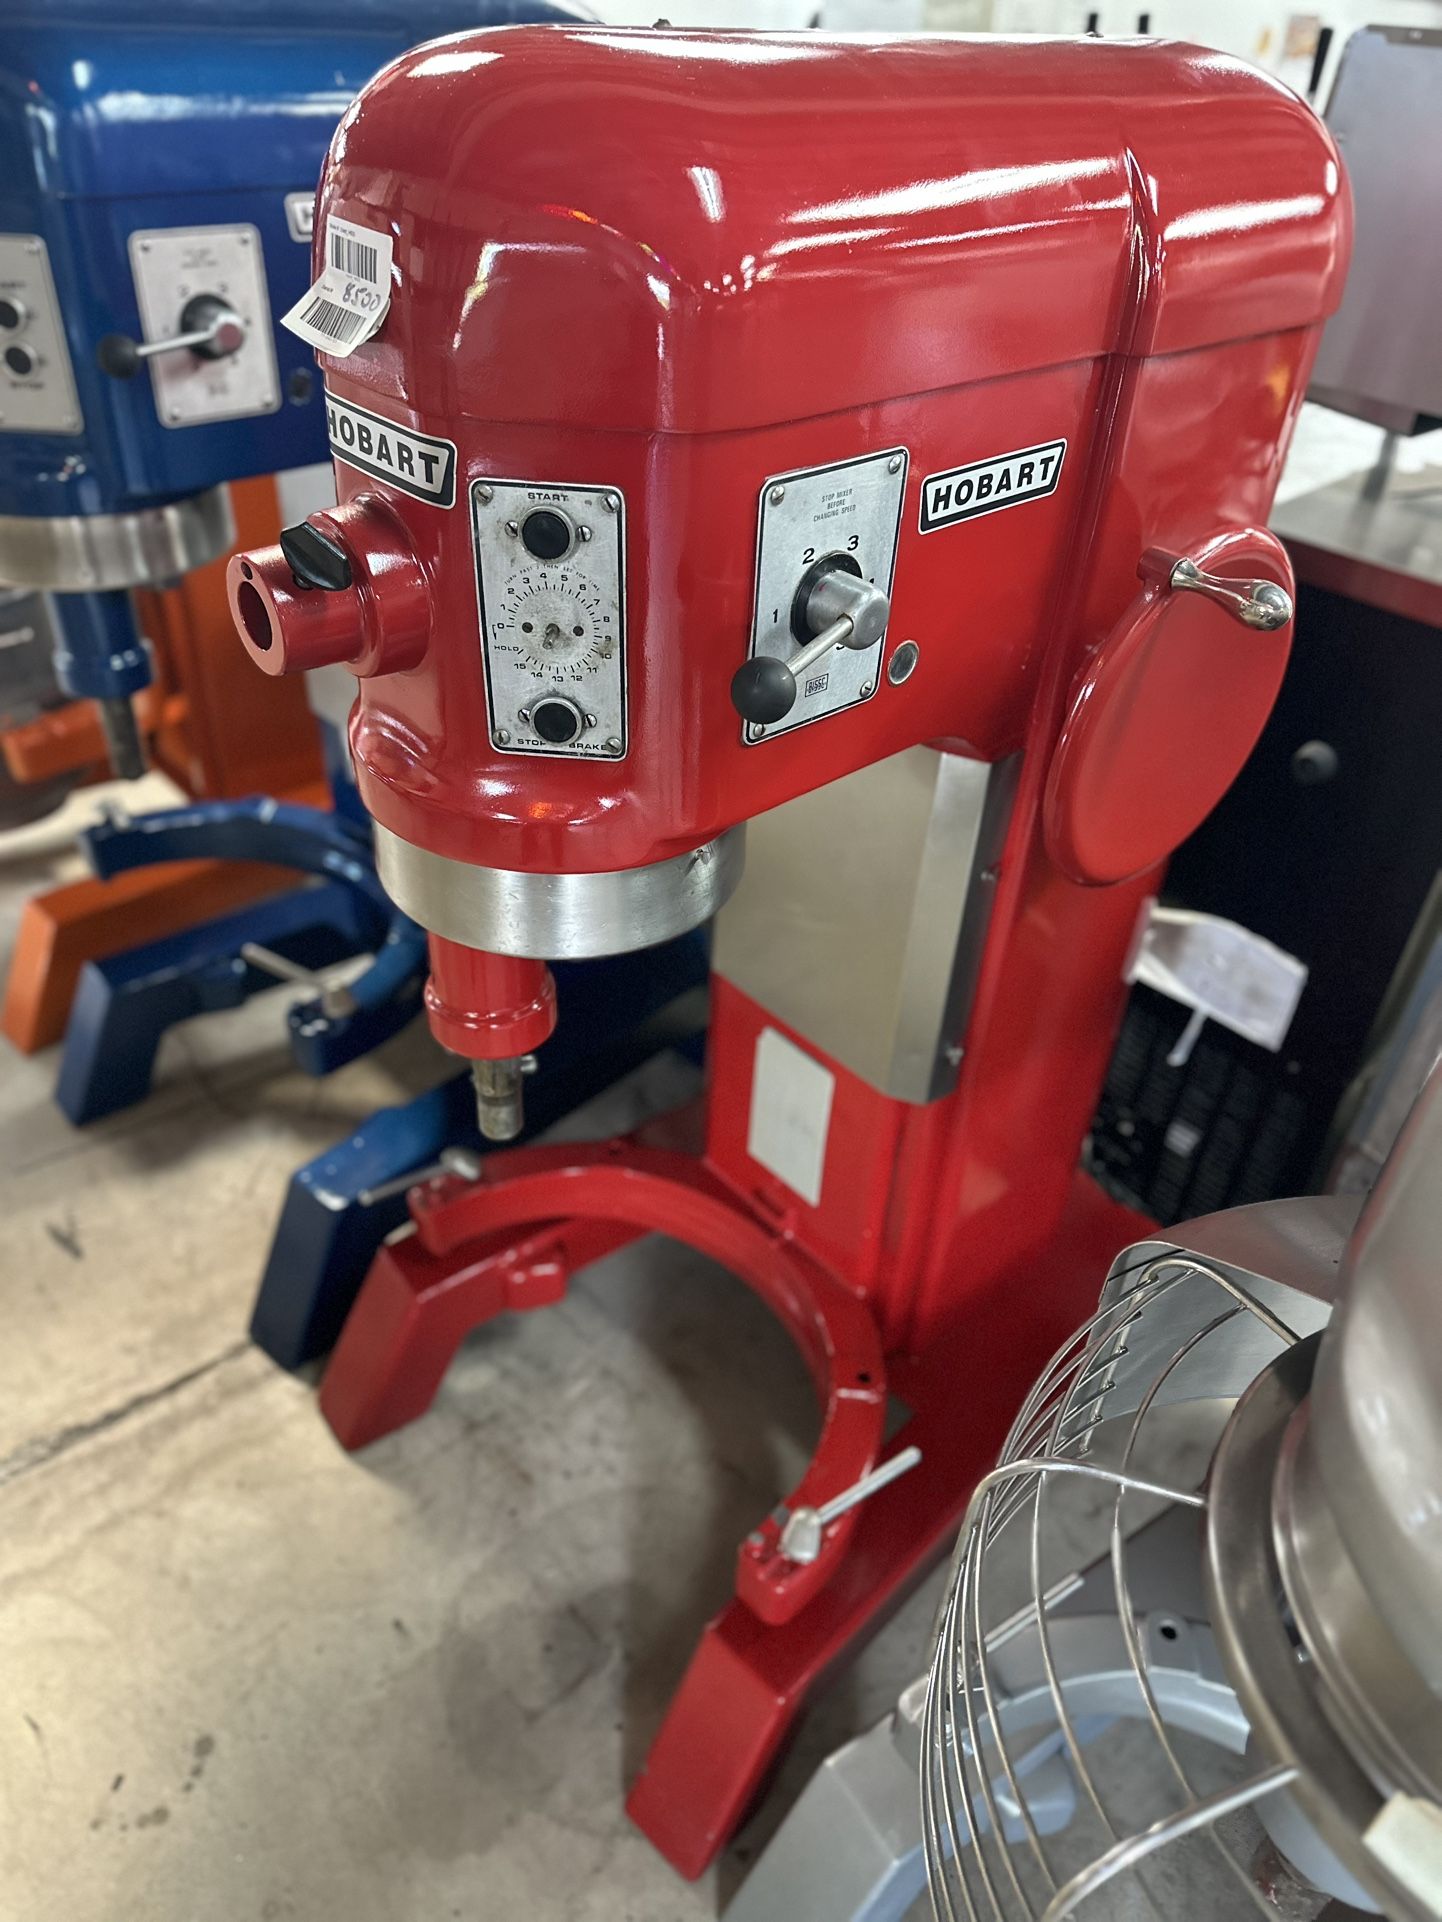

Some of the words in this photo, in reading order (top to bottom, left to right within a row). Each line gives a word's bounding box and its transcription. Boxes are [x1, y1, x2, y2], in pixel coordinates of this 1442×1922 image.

[342, 281, 382, 312] 8500
[326, 405, 440, 484] HOBART
[931, 455, 1057, 515] HOBART
[527, 492, 568, 502] START
[821, 492, 835, 503] STOP
[836, 488, 853, 499] MIXER
[827, 498, 846, 510] BEFORE
[813, 509, 839, 522] CHANGING
[841, 503, 857, 514] SPEED
[847, 534, 859, 551] 3
[802, 547, 815, 565] 2
[560, 574, 568, 582] 5
[576, 571, 586, 580] FOR
[588, 579, 600, 592] TIME
[593, 598, 600, 606] 7
[603, 615, 610, 623] 8
[772, 608, 778, 623] 1
[514, 662, 526, 670] 15
[586, 666, 598, 674] 11
[531, 671, 544, 679] 14
[552, 675, 564, 683] 13
[570, 674, 583, 682] 12
[568, 743, 607, 751] BRAKE
